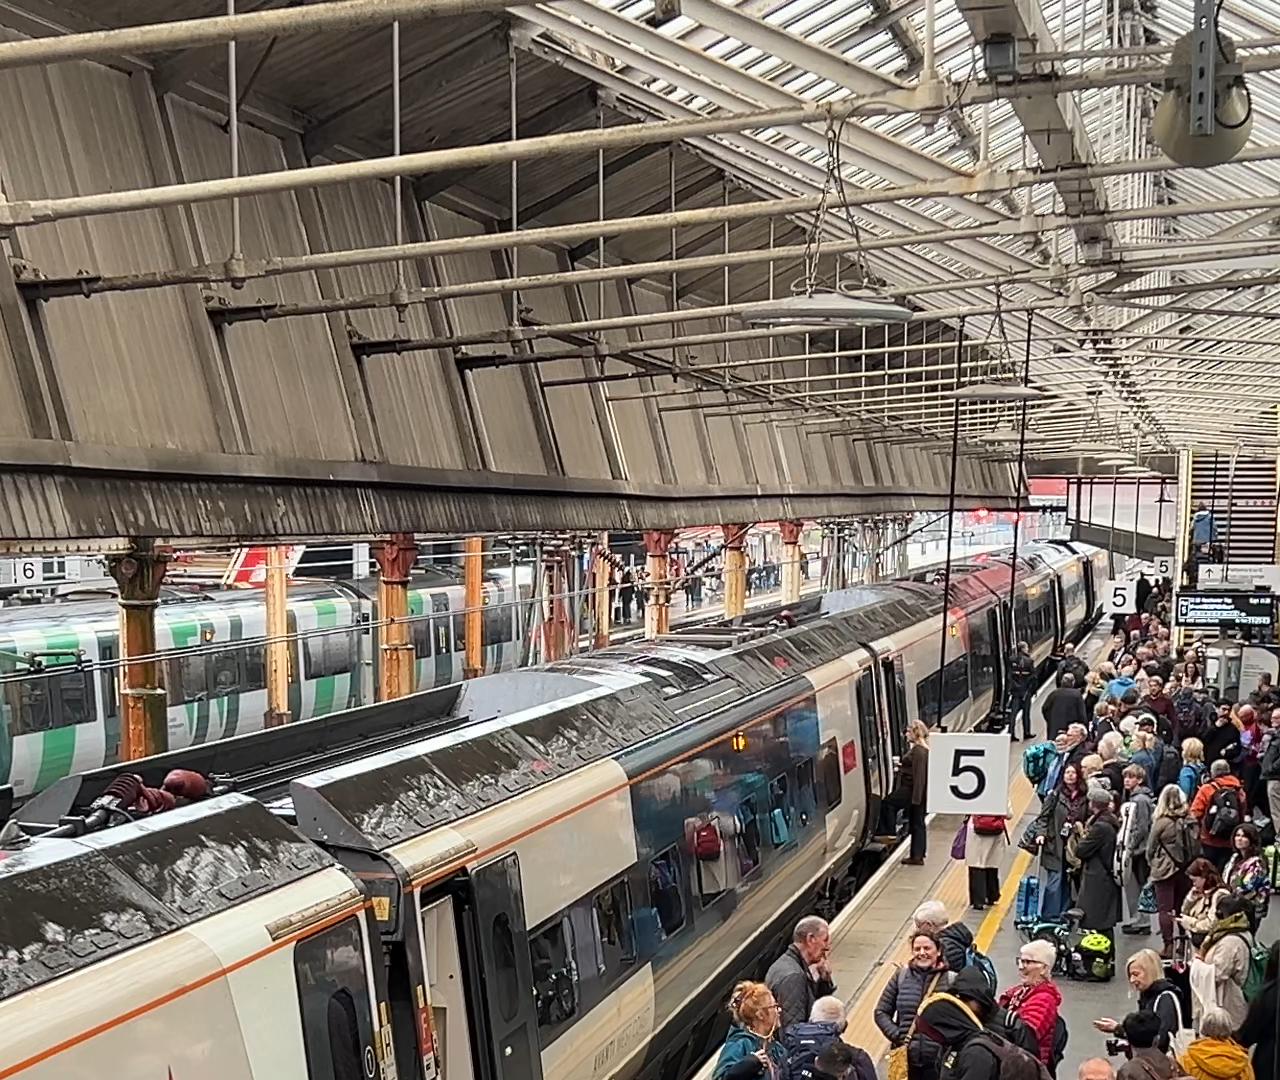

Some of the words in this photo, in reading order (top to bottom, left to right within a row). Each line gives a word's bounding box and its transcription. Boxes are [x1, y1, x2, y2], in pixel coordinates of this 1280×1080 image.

[22, 562, 35, 579] 6
[1159, 560, 1169, 574] 5
[1112, 587, 1127, 608] 5
[949, 749, 986, 801] 5
